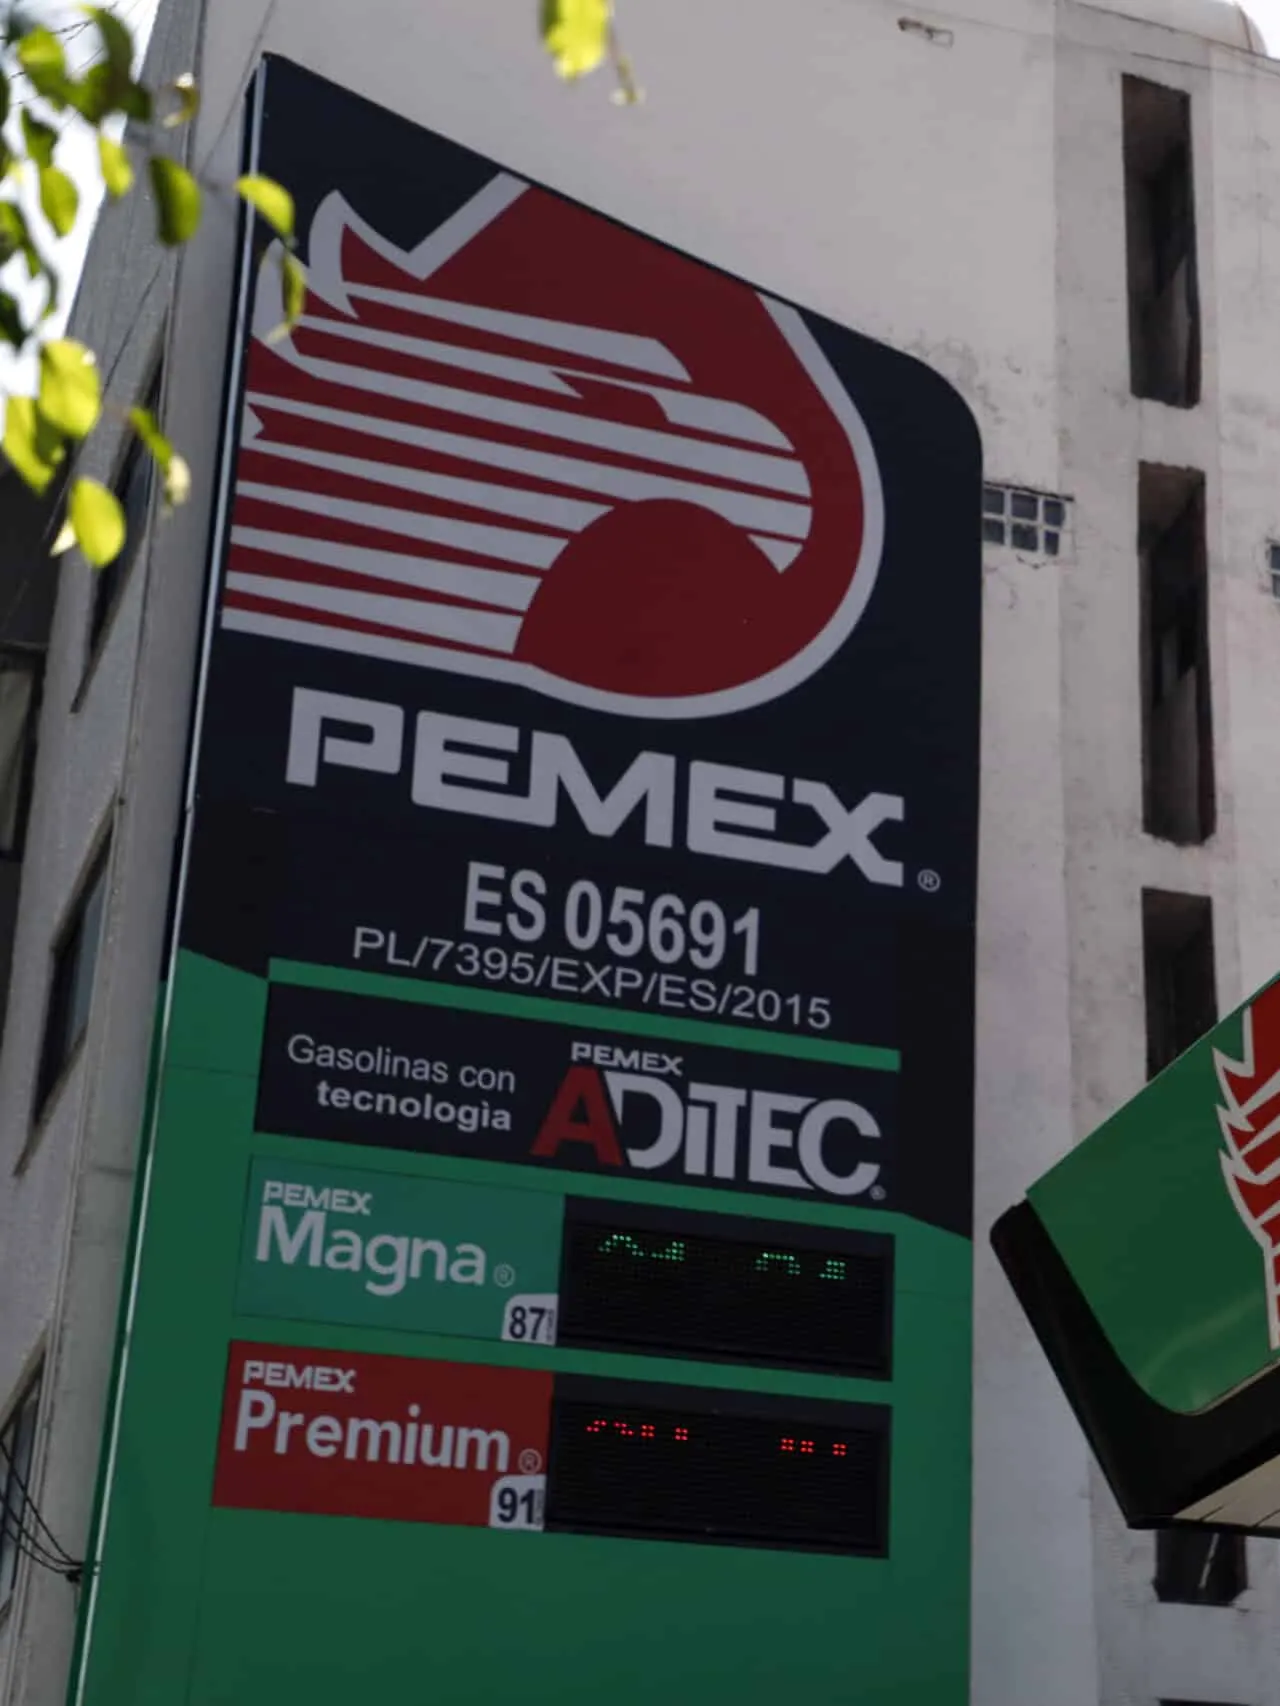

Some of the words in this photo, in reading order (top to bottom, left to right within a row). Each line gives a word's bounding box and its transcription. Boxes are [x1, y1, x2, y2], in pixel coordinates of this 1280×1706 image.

[285, 686, 905, 887] PEMEX
[463, 861, 547, 941] ES
[564, 880, 760, 976] 05691
[353, 926, 831, 1029] PL/7395/EXP/ES/2015
[287, 1034, 449, 1084] Gasolinas
[459, 1065, 516, 1093] con
[571, 1041, 684, 1076] PEMEX
[263, 1180, 373, 1216] PEMEX
[255, 1204, 487, 1296] Magna
[509, 1305, 547, 1341] 87
[243, 1359, 356, 1393] PEMEX
[234, 1388, 511, 1473] Premium
[497, 1487, 535, 1524] 91
